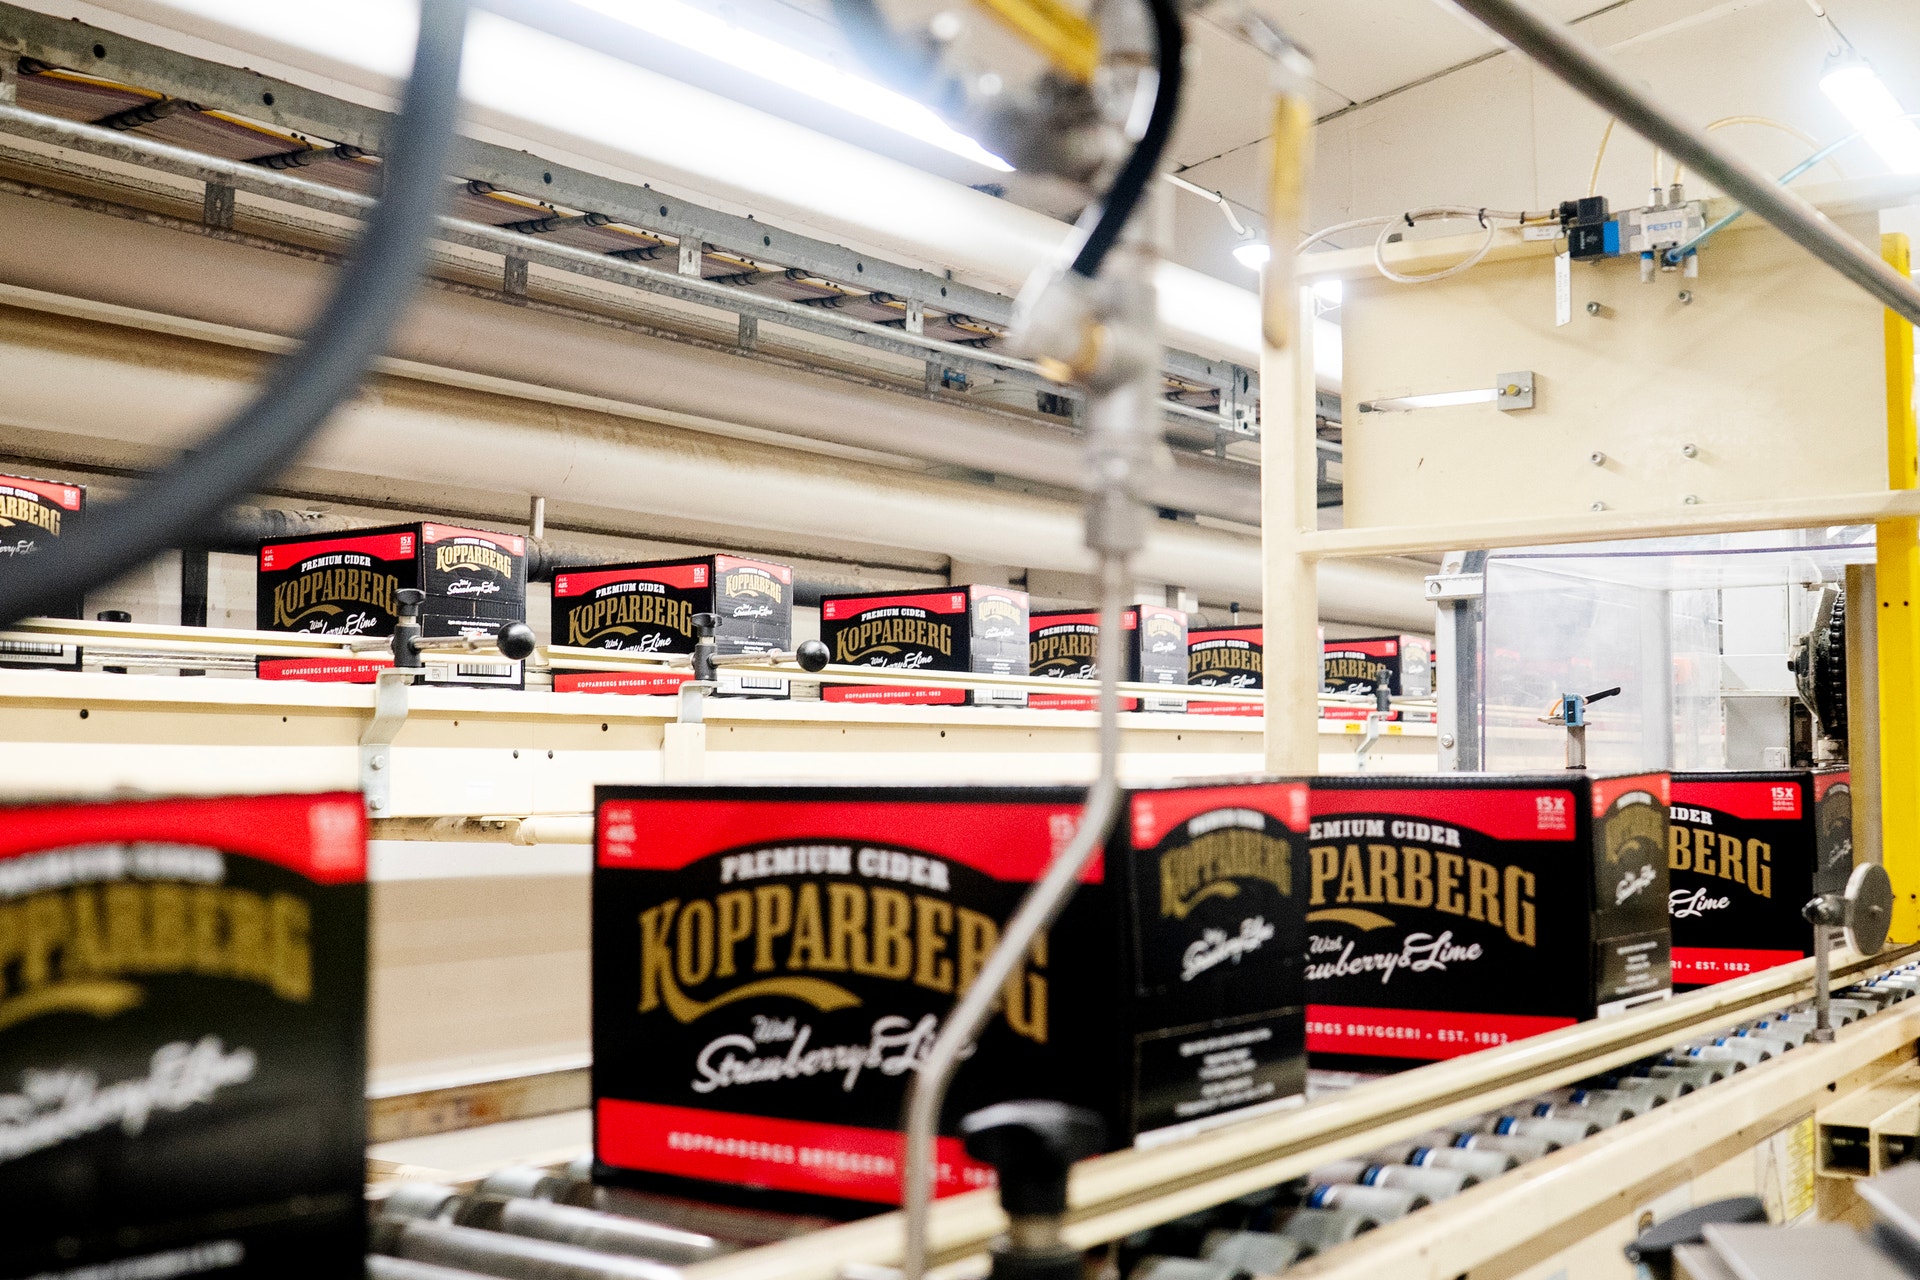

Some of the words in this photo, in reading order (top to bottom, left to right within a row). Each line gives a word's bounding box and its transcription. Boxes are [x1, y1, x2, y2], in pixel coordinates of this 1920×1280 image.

[1647, 221, 1682, 232] FESTO
[0, 495, 61, 537] ARBERG
[400, 536, 412, 544] 15X
[301, 555, 342, 573] PREMIUM
[344, 554, 371, 567] CIDER
[436, 545, 512, 579] KOPPARBERG
[273, 568, 399, 628] KOPPARBERG
[595, 582, 637, 599] PREMIUM
[638, 583, 666, 594] CIDER
[725, 574, 782, 604] KOPPARBERG
[568, 594, 693, 646] KOPPARBERG
[861, 608, 899, 622] PREMIUM
[900, 607, 926, 619] CIDER
[835, 618, 952, 663] KOPPARBERG
[1039, 625, 1075, 637] PREMIUM
[282, 667, 322, 675] KOPPARBERGS
[323, 666, 352, 674] BRYGGERI
[1188, 648, 1263, 675] PPARBER
[1770, 787, 1794, 798] 15X
[1535, 795, 1566, 812] 15X
[1669, 806, 1713, 826] IDER
[1309, 819, 1386, 841] EMIUM
[1391, 819, 1462, 848] CIDER
[720, 845, 854, 885] PREMIUM
[857, 846, 951, 892] CIDER
[1306, 843, 1536, 948] PARBERG
[1695, 960, 1720, 971] EST.
[1723, 961, 1750, 972] 1882
[1346, 1023, 1421, 1041] BRYGGERI
[1437, 1028, 1469, 1043] EST.
